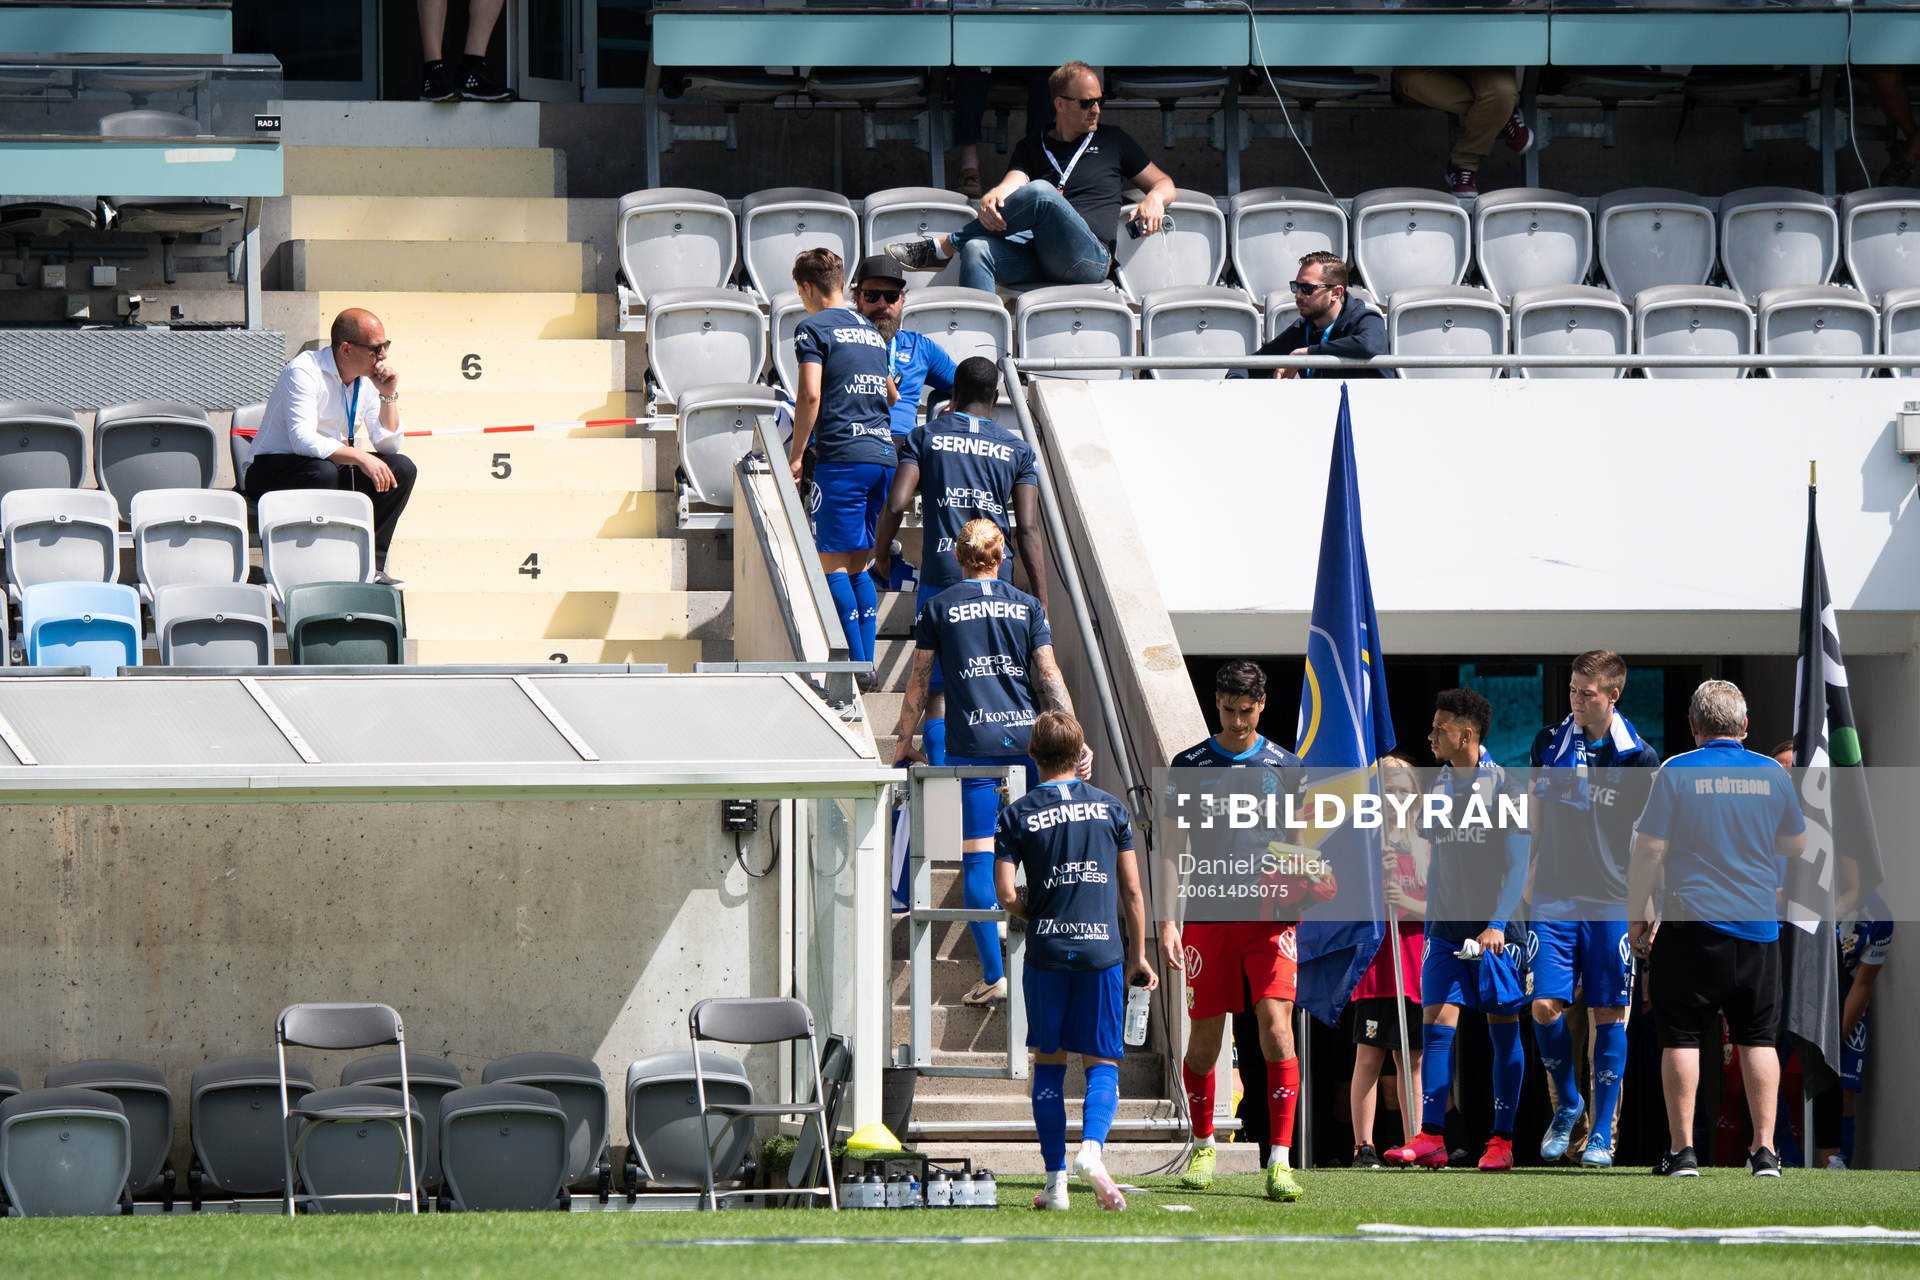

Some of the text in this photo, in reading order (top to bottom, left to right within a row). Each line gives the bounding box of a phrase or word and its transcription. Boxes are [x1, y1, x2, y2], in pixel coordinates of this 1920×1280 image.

[461, 353, 482, 380] 6
[931, 435, 1011, 462] SERNEKE
[490, 452, 512, 480] 5
[937, 497, 1003, 515] WELLNESS
[518, 553, 541, 580] 4
[948, 601, 1027, 624] SERNEKE
[1695, 779, 1713, 795] IFK
[1027, 802, 1109, 833] SERNEKE
